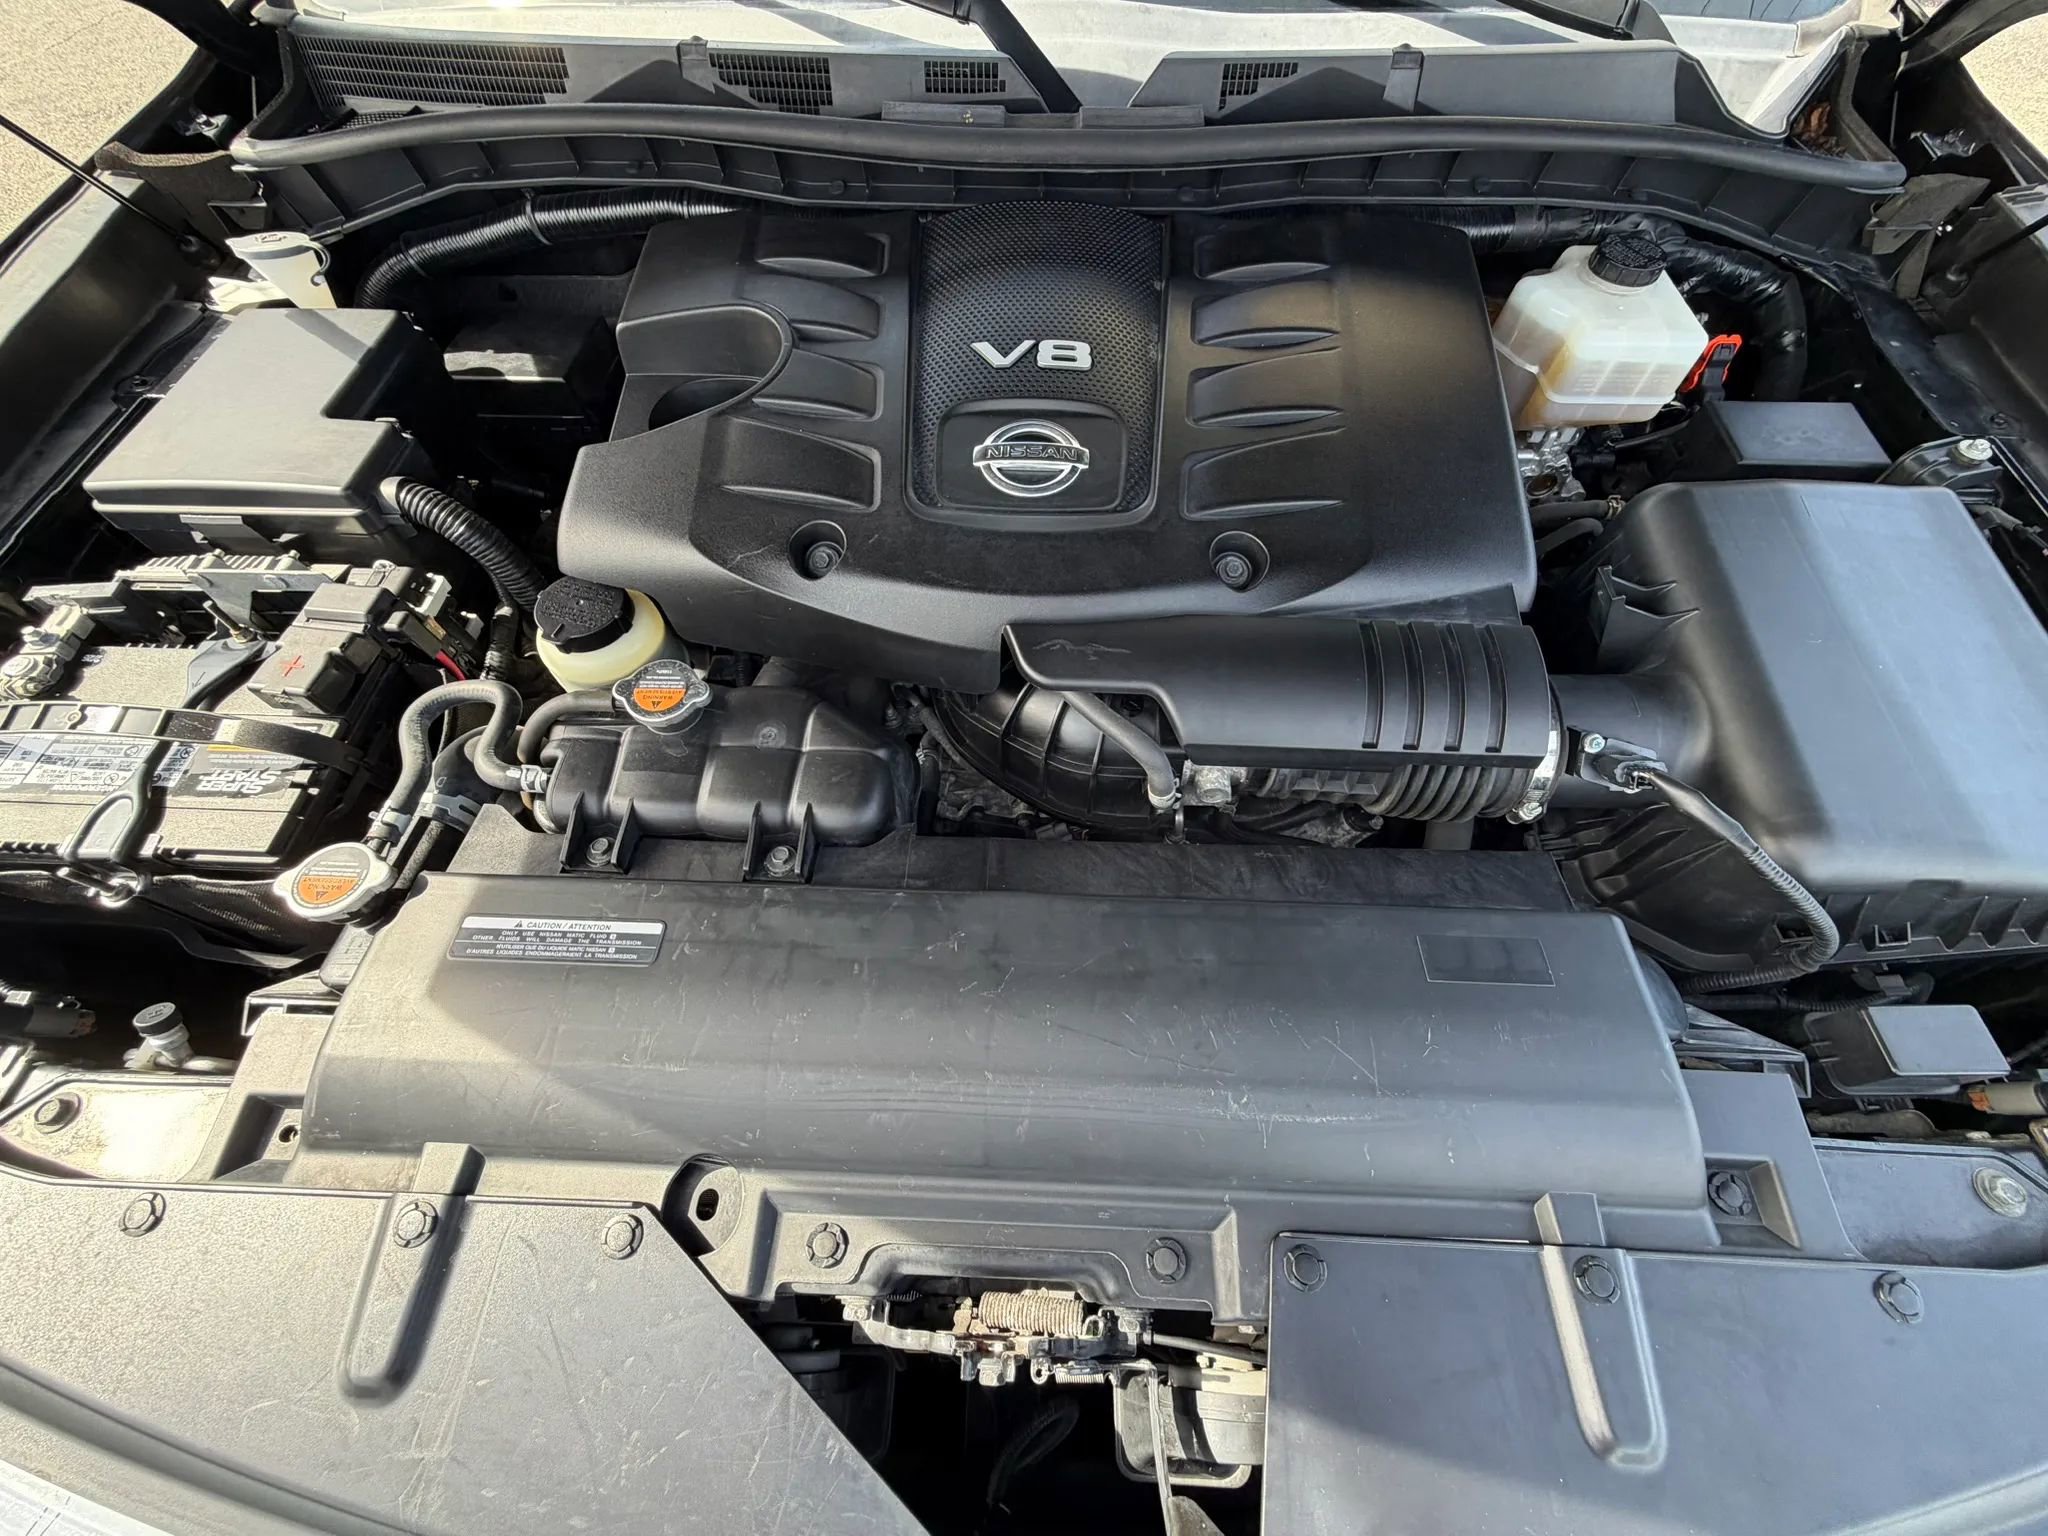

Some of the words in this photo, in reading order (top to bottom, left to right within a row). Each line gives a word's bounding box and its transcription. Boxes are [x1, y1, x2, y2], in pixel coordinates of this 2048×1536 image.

[970, 339, 1093, 370] V8
[985, 445, 1079, 461] NISSAN
[203, 766, 282, 786] START
[196, 780, 264, 794] SUPER
[526, 921, 562, 930] CAUTION
[568, 922, 612, 931] ATTENTION
